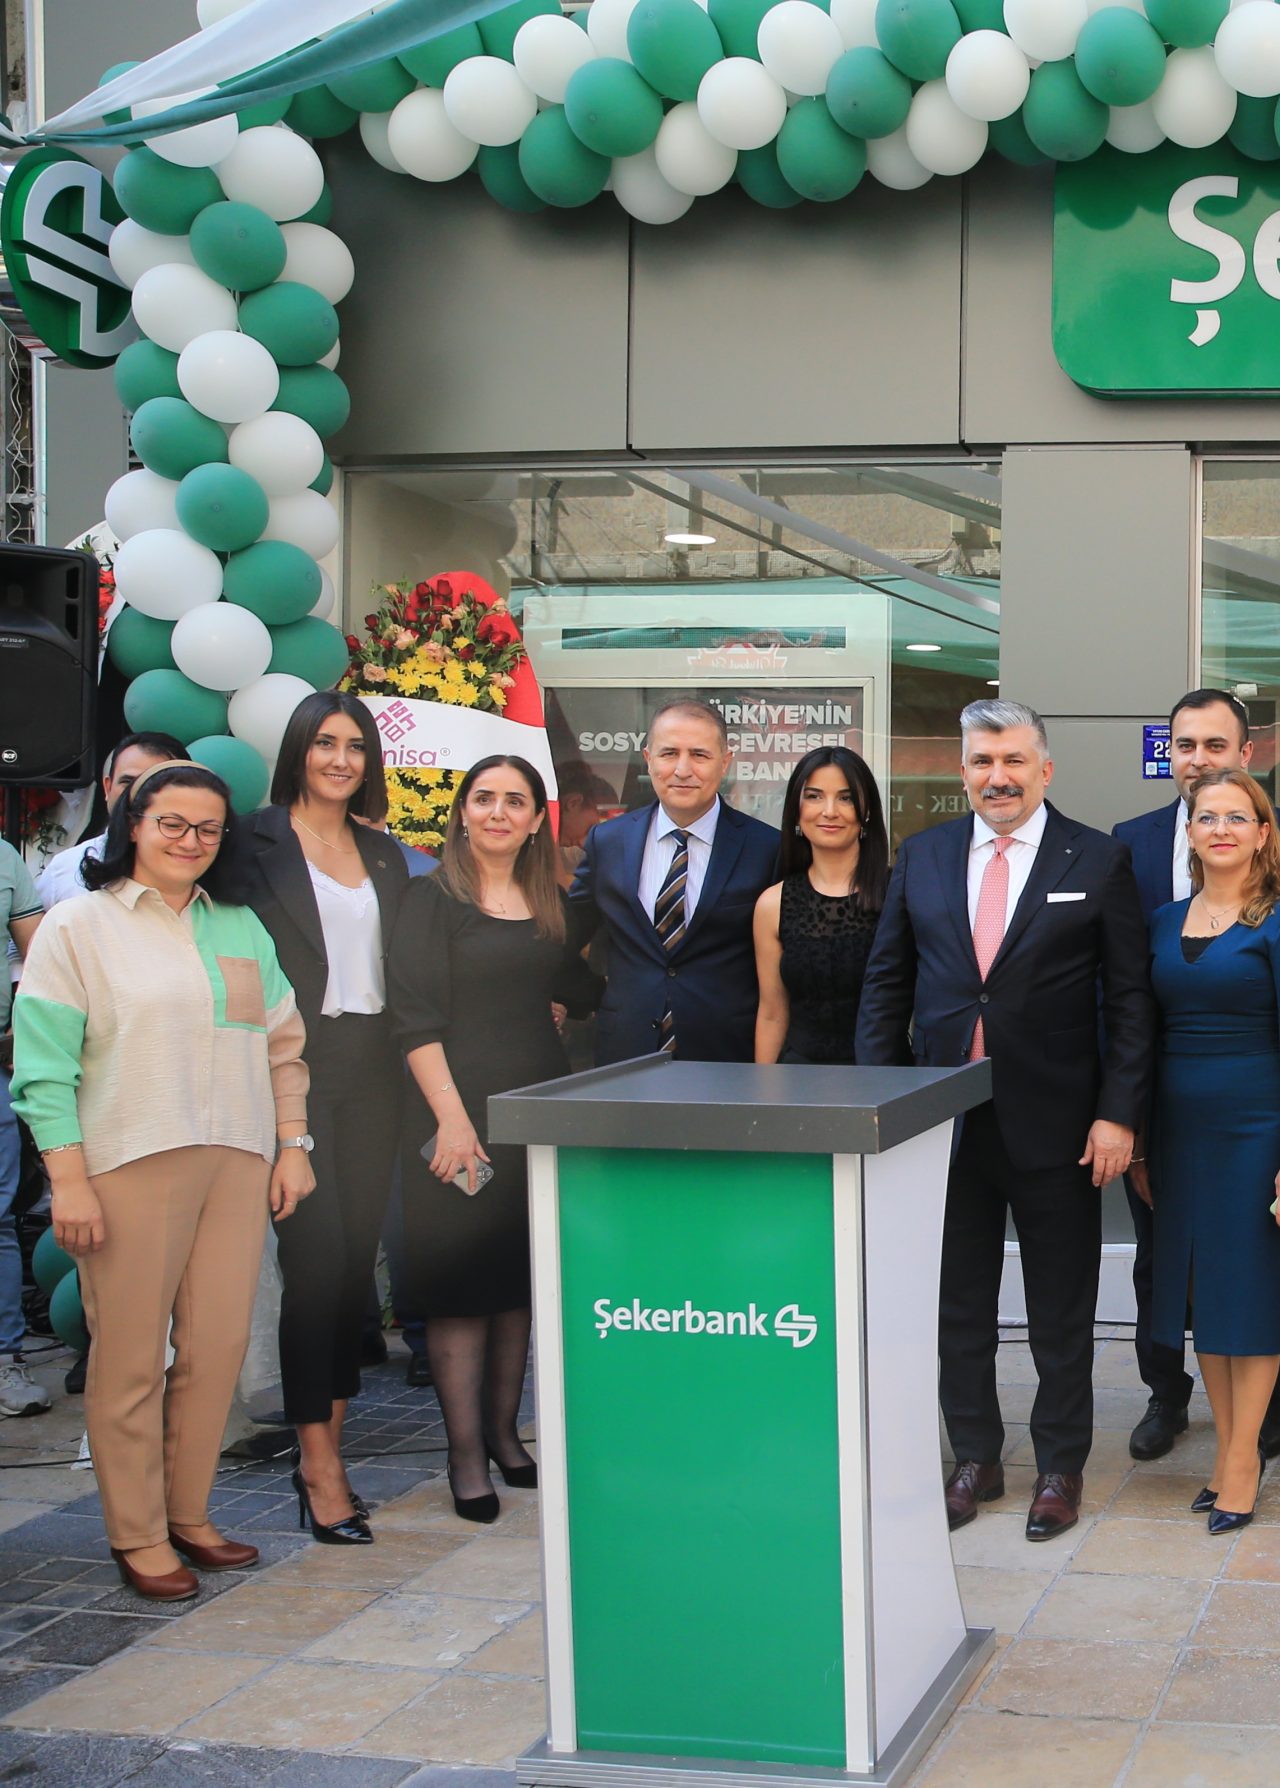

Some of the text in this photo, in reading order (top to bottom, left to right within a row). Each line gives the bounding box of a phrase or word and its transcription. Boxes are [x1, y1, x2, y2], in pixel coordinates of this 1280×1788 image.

[709, 698, 852, 725] RKİYE'NİN
[578, 731, 647, 752] SOSY
[382, 744, 438, 766] nisa
[736, 761, 799, 781] BAN
[593, 1298, 769, 1340] Şekerbank
